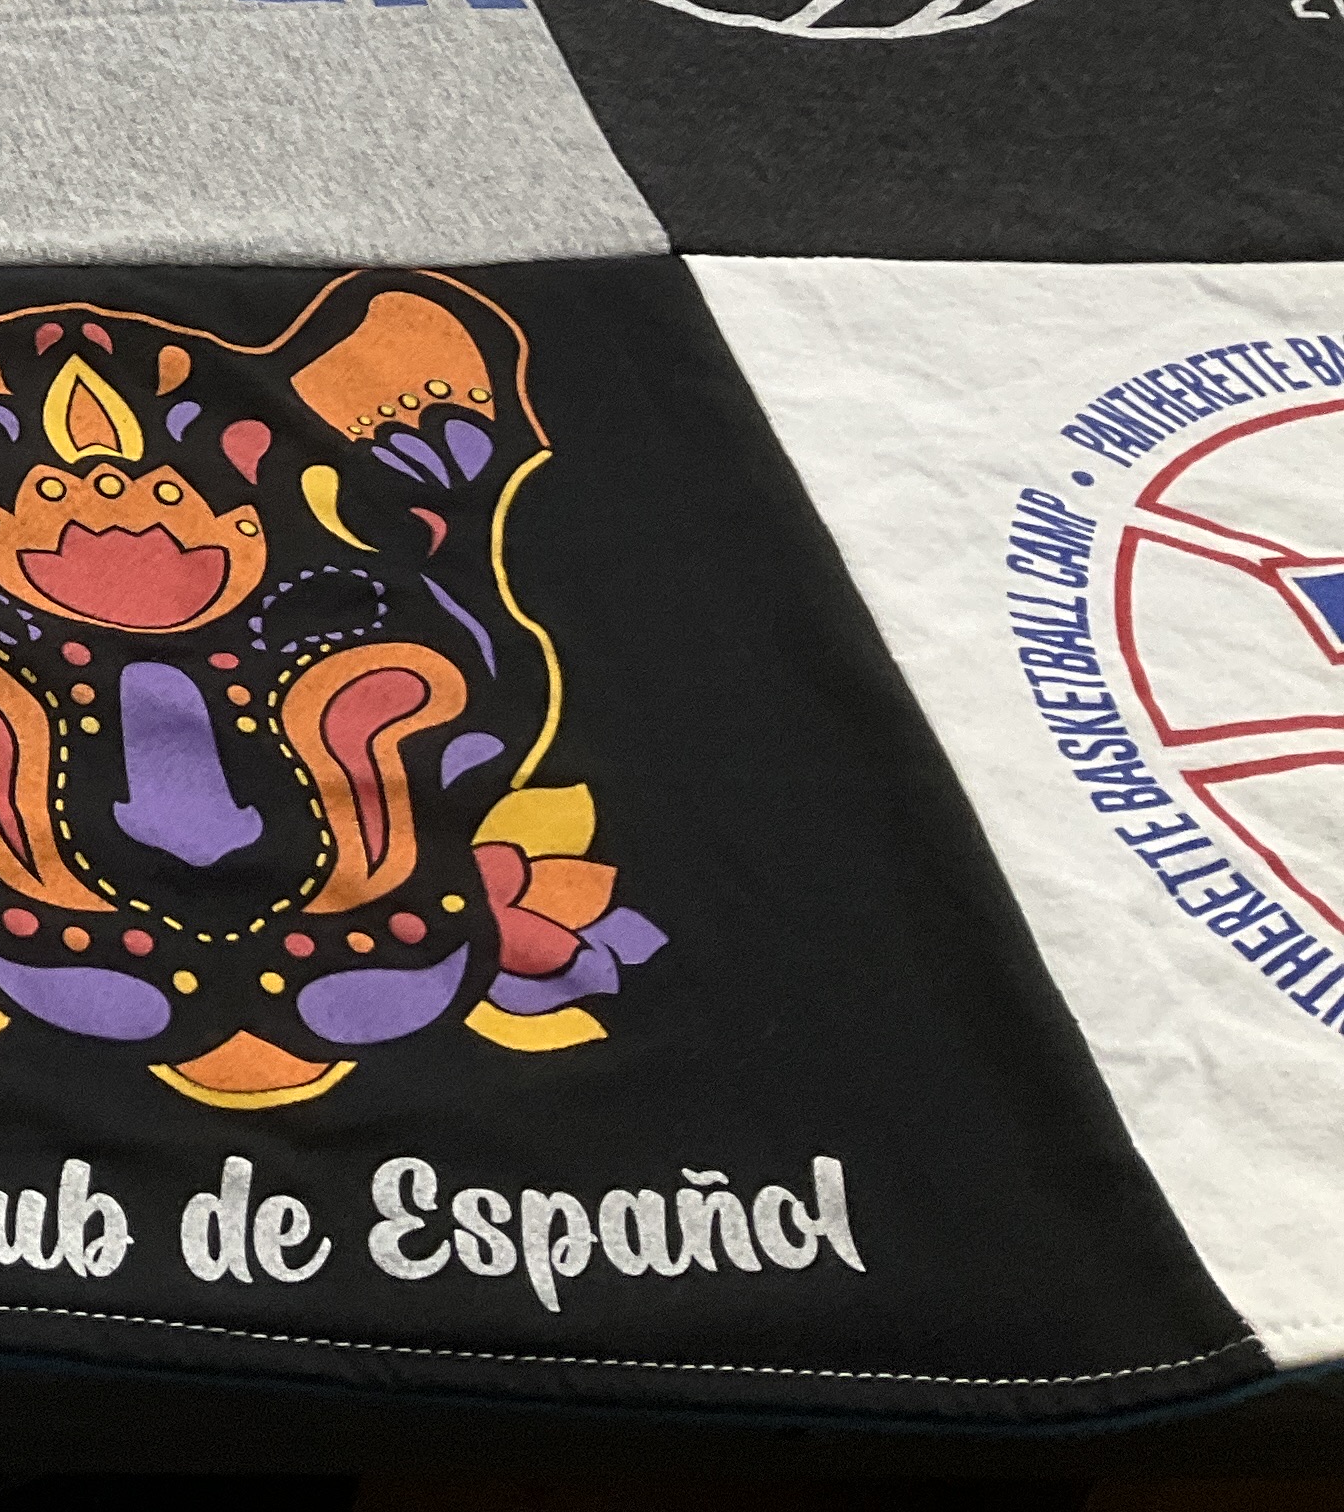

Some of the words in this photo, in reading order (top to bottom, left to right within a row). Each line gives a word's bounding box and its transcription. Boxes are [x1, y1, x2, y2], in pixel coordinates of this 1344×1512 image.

[1060, 340, 1313, 469] PANTHERETTE
[1005, 487, 1098, 589] CAMP
[1006, 591, 1175, 814] BASKETBALL
[180, 1156, 333, 1284] de
[366, 1155, 868, 1313] Español
